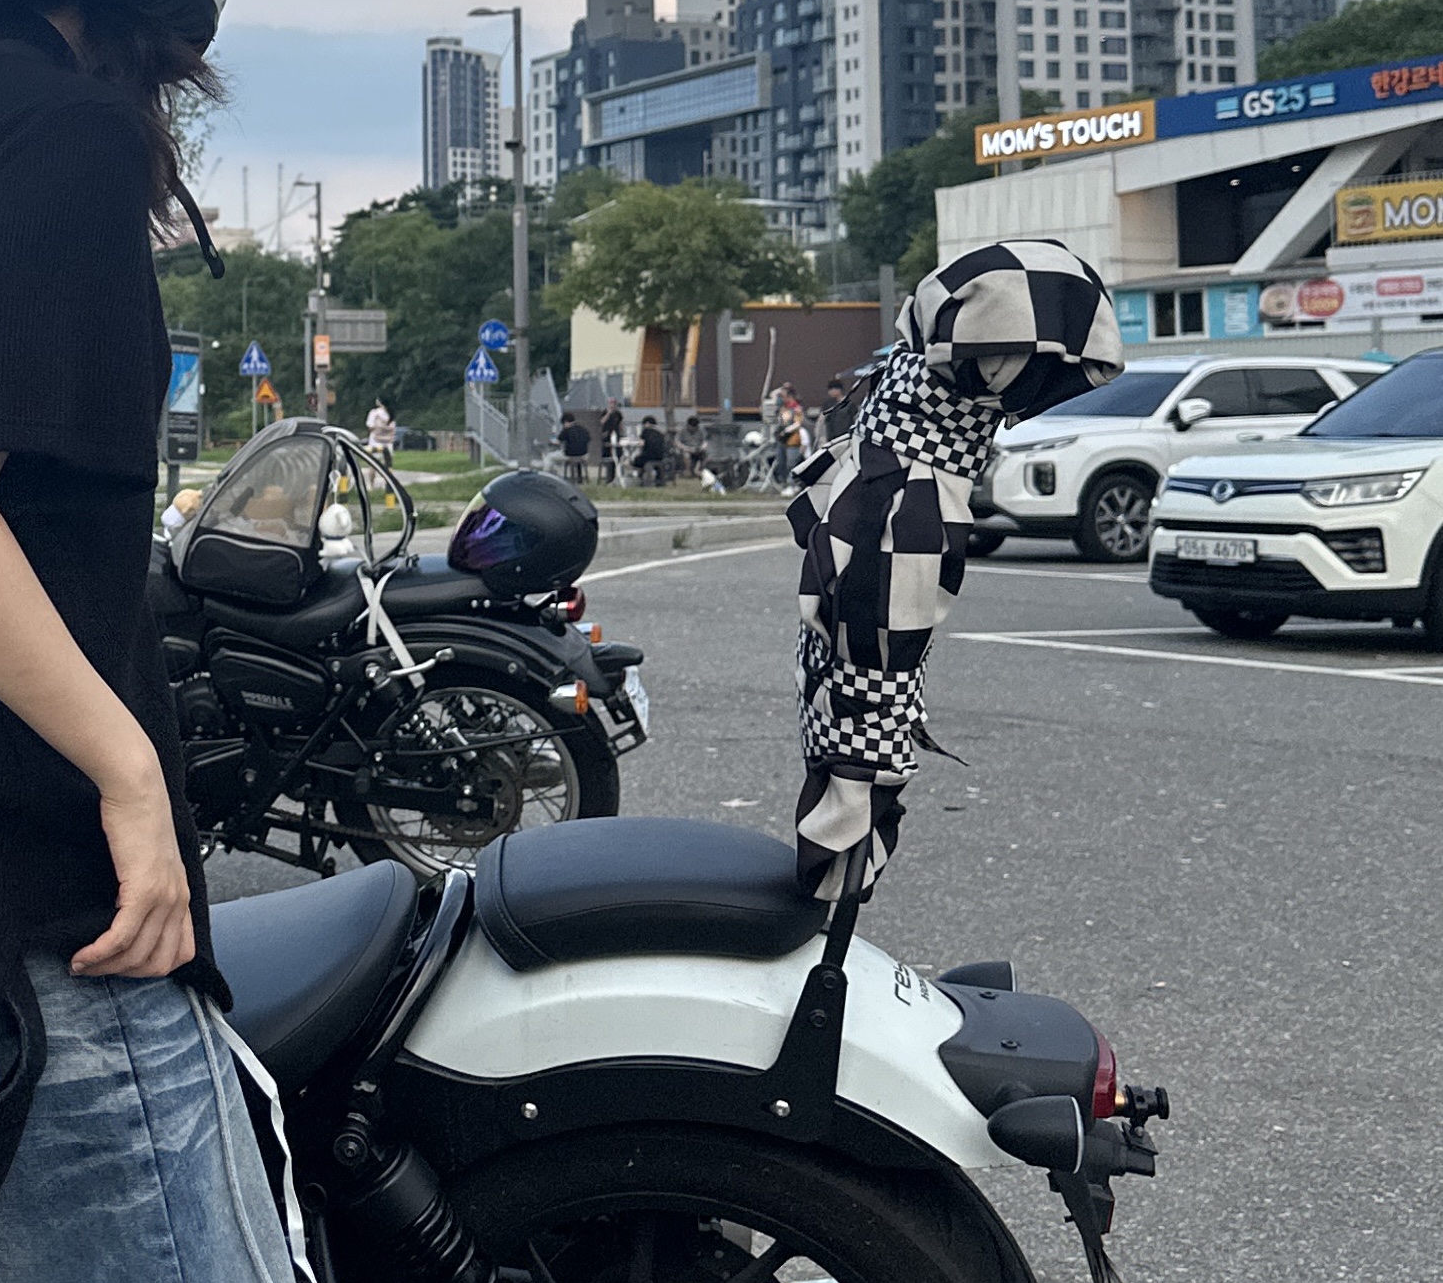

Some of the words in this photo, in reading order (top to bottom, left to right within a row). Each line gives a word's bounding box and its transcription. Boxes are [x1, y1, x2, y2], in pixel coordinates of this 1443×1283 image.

[1243, 84, 1305, 118] GS25
[982, 121, 1054, 157] MOM'S
[1058, 111, 1141, 146] TOUCH
[1384, 196, 1443, 229] MO
